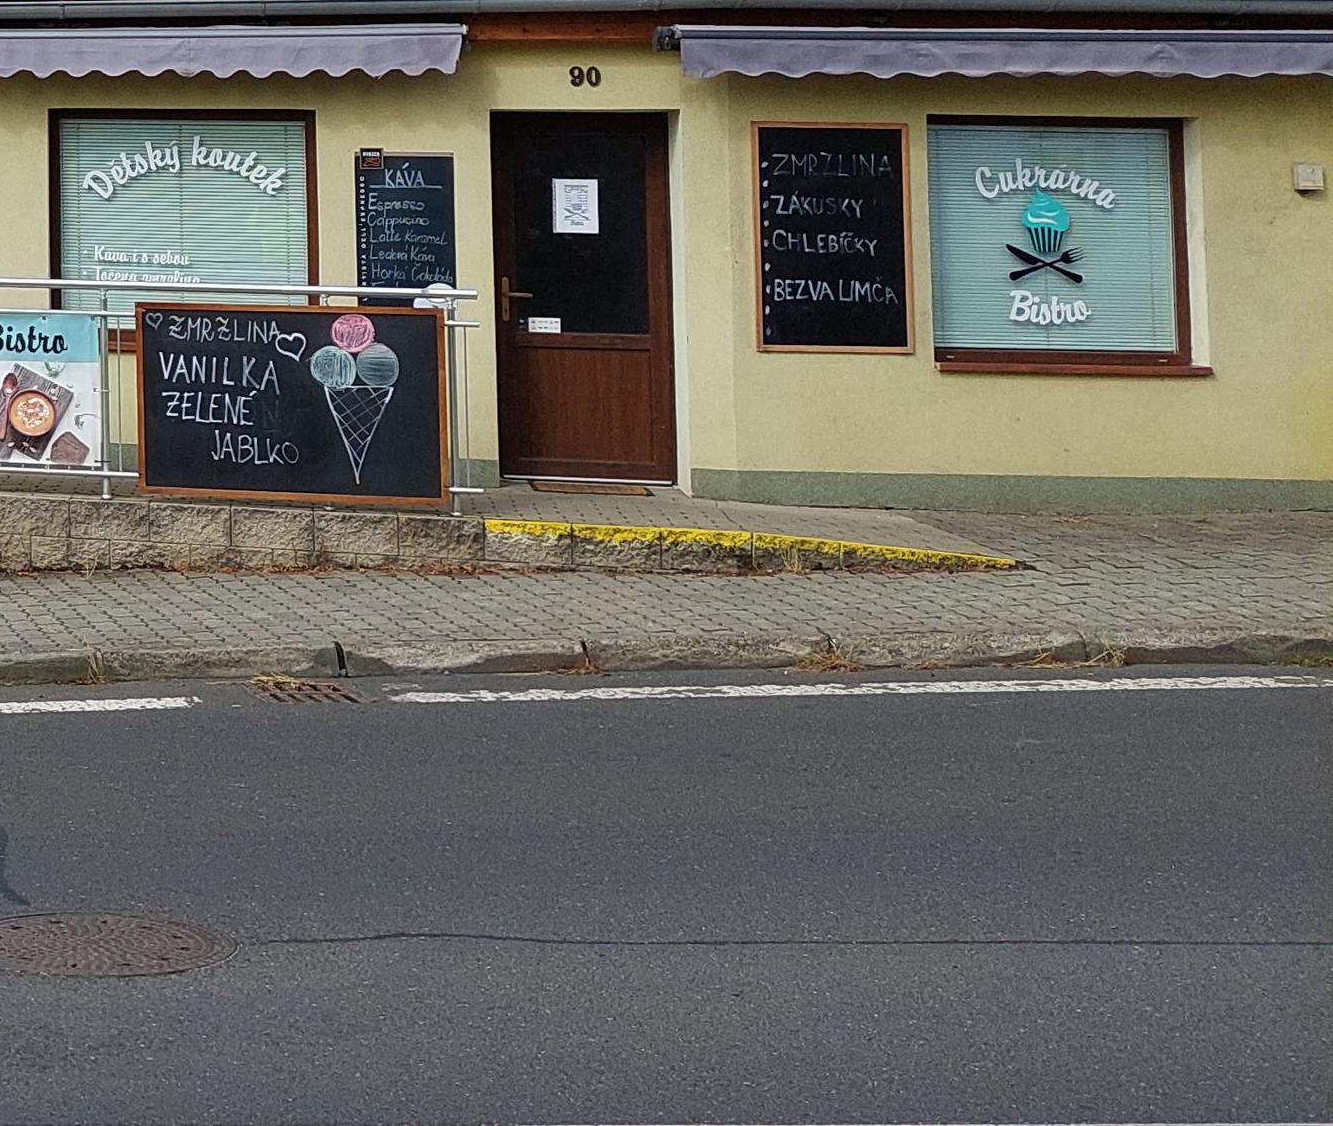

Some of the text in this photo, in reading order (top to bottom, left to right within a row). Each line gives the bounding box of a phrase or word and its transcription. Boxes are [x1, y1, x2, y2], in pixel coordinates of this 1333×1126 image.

[569, 65, 602, 88] 90
[82, 135, 286, 200] Dětský koutek
[384, 162, 426, 188] KÁVA
[975, 157, 1116, 209] Cukrárna
[770, 190, 864, 219] ZÁKUSKY
[773, 278, 836, 302] BEZVA
[1009, 289, 1092, 325] Bistro
[168, 314, 281, 345] ZMRZLINA
[159, 351, 281, 396] VANILKA
[161, 390, 258, 426] ZELENÉ
[211, 429, 300, 465] JABLKO
